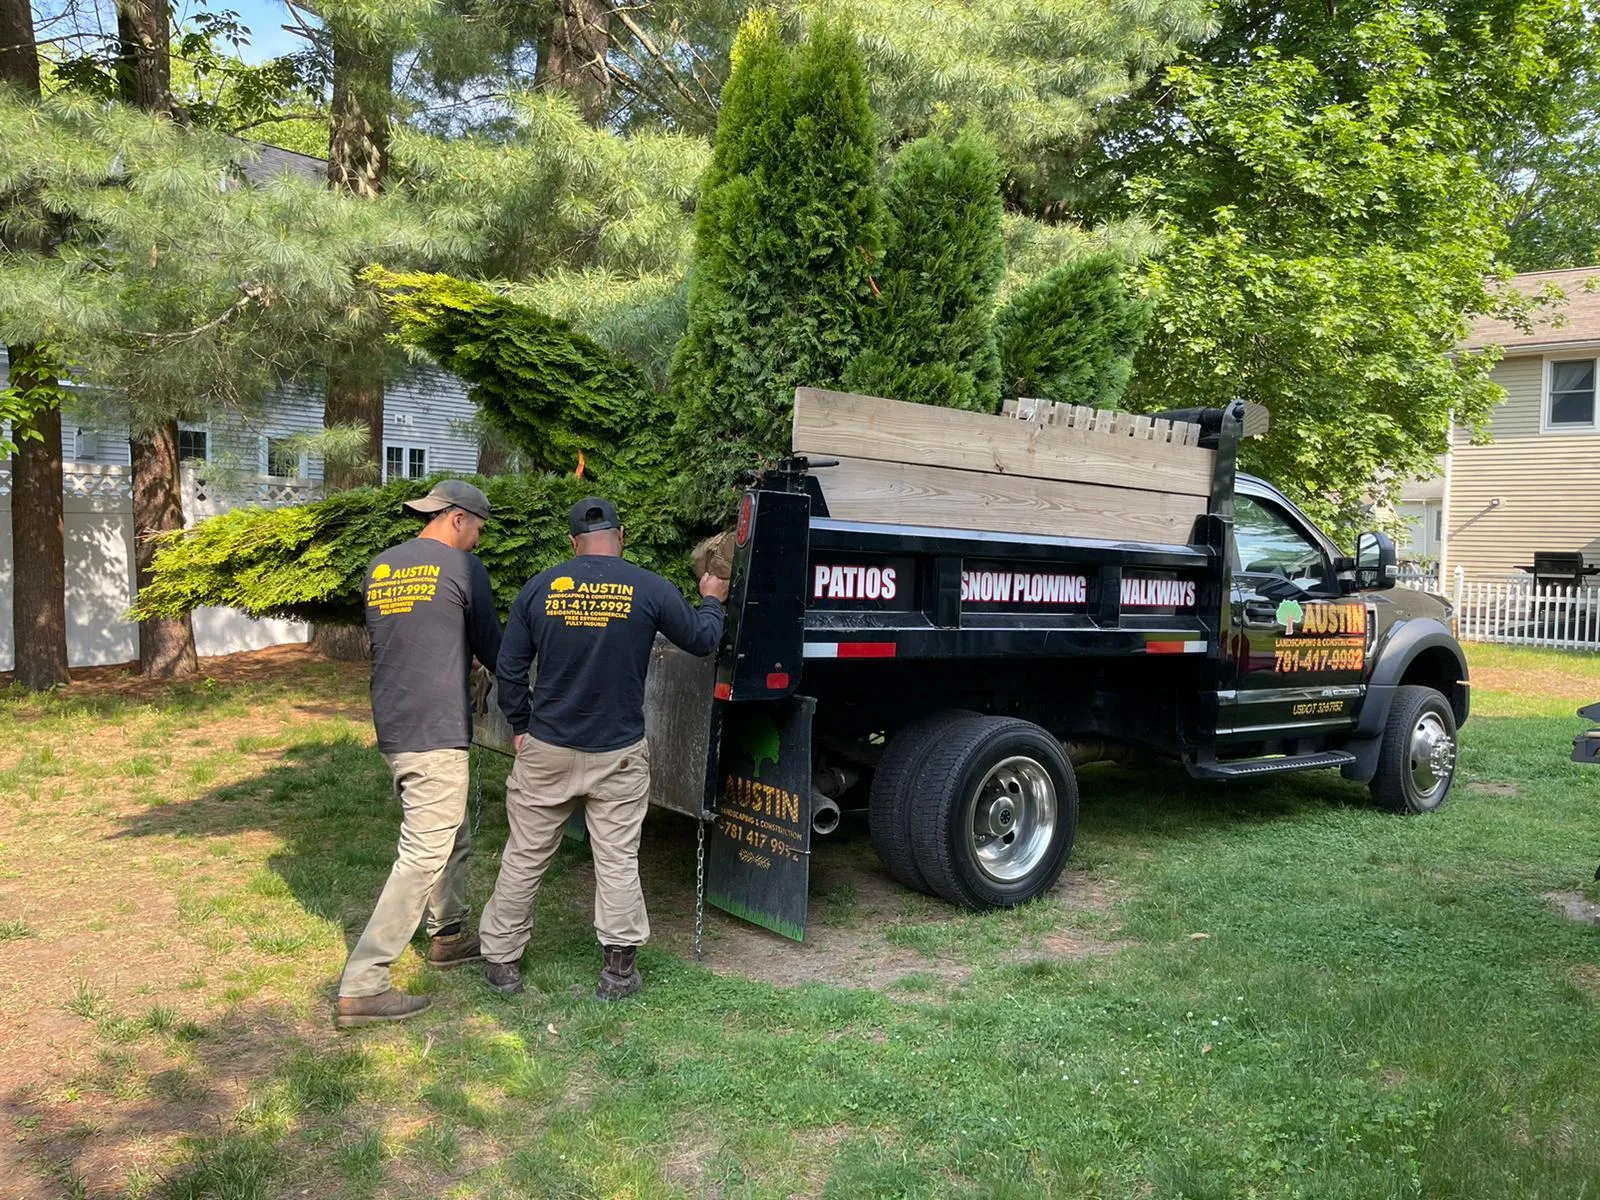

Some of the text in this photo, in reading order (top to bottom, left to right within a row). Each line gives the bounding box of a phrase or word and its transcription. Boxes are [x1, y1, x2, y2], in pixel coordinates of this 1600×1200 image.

[392, 565, 440, 579] AUSTIN
[577, 582, 634, 595] AUSTIN
[814, 565, 896, 599] PATIOS
[961, 571, 1087, 603] SNOW PLOWING
[366, 584, 436, 601] 781-417-9992
[1120, 578, 1196, 606] WALKWAYS
[545, 599, 631, 613] 781-417-9992
[590, 611, 628, 619] COMMERCIAL
[1302, 604, 1365, 633] AUSTIN
[1275, 638, 1315, 648] LANDSCAPING
[1316, 638, 1321, 647] &
[1274, 648, 1364, 673] 781-417-9992
[1292, 702, 1316, 715] USDOT
[724, 774, 799, 823] AUSTIN
[746, 830, 768, 849] 417
[760, 820, 802, 841] CONSTRUCTION
